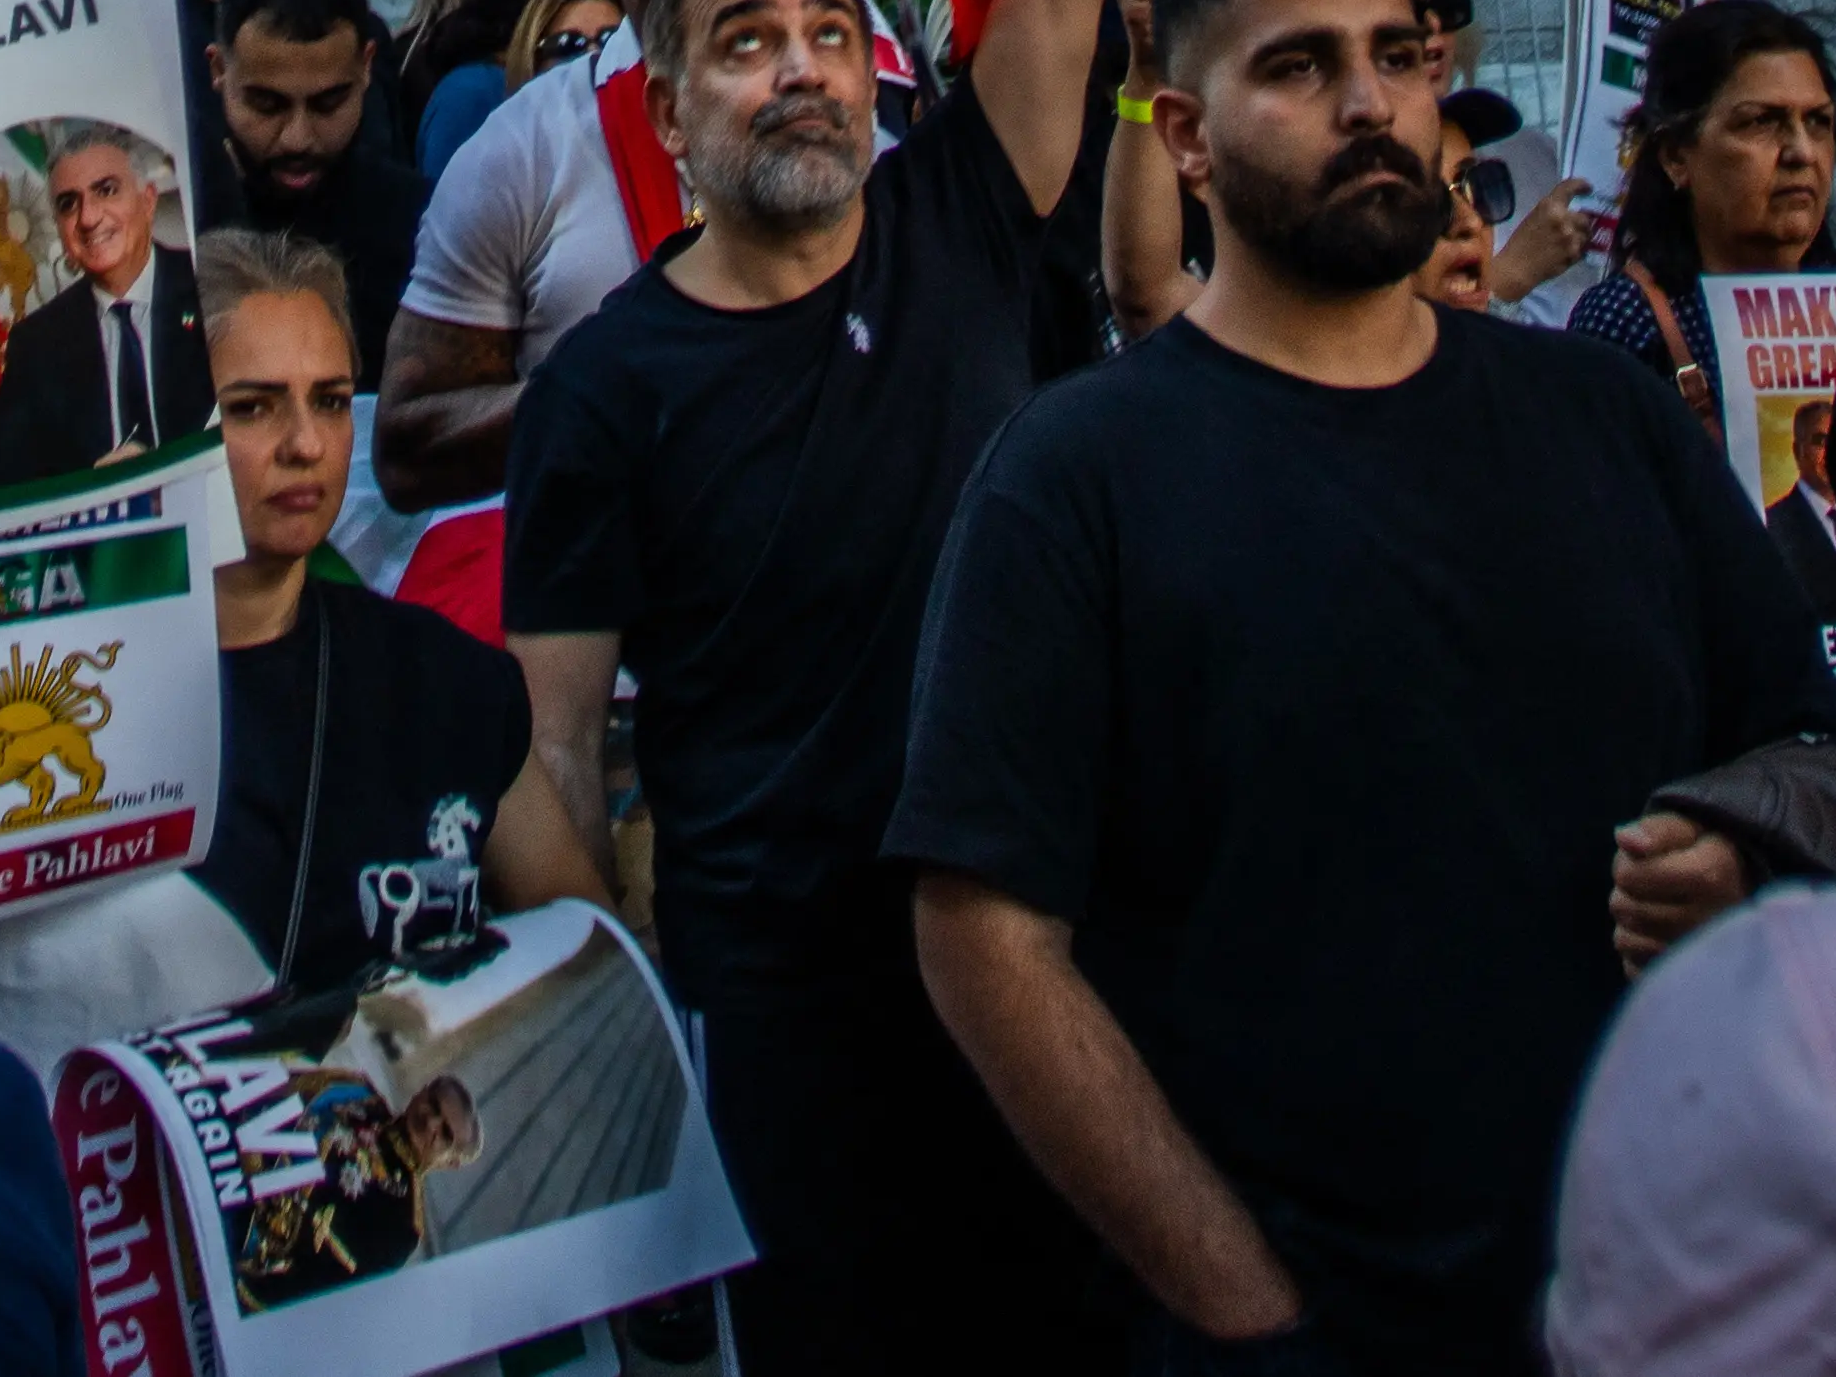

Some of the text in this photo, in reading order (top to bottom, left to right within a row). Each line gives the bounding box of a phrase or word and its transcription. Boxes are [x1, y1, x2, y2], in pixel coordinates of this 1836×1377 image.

[22, 826, 156, 889] Pahlavi
[155, 1009, 326, 1202] LAVI
[77, 1113, 162, 1377] Pahla
